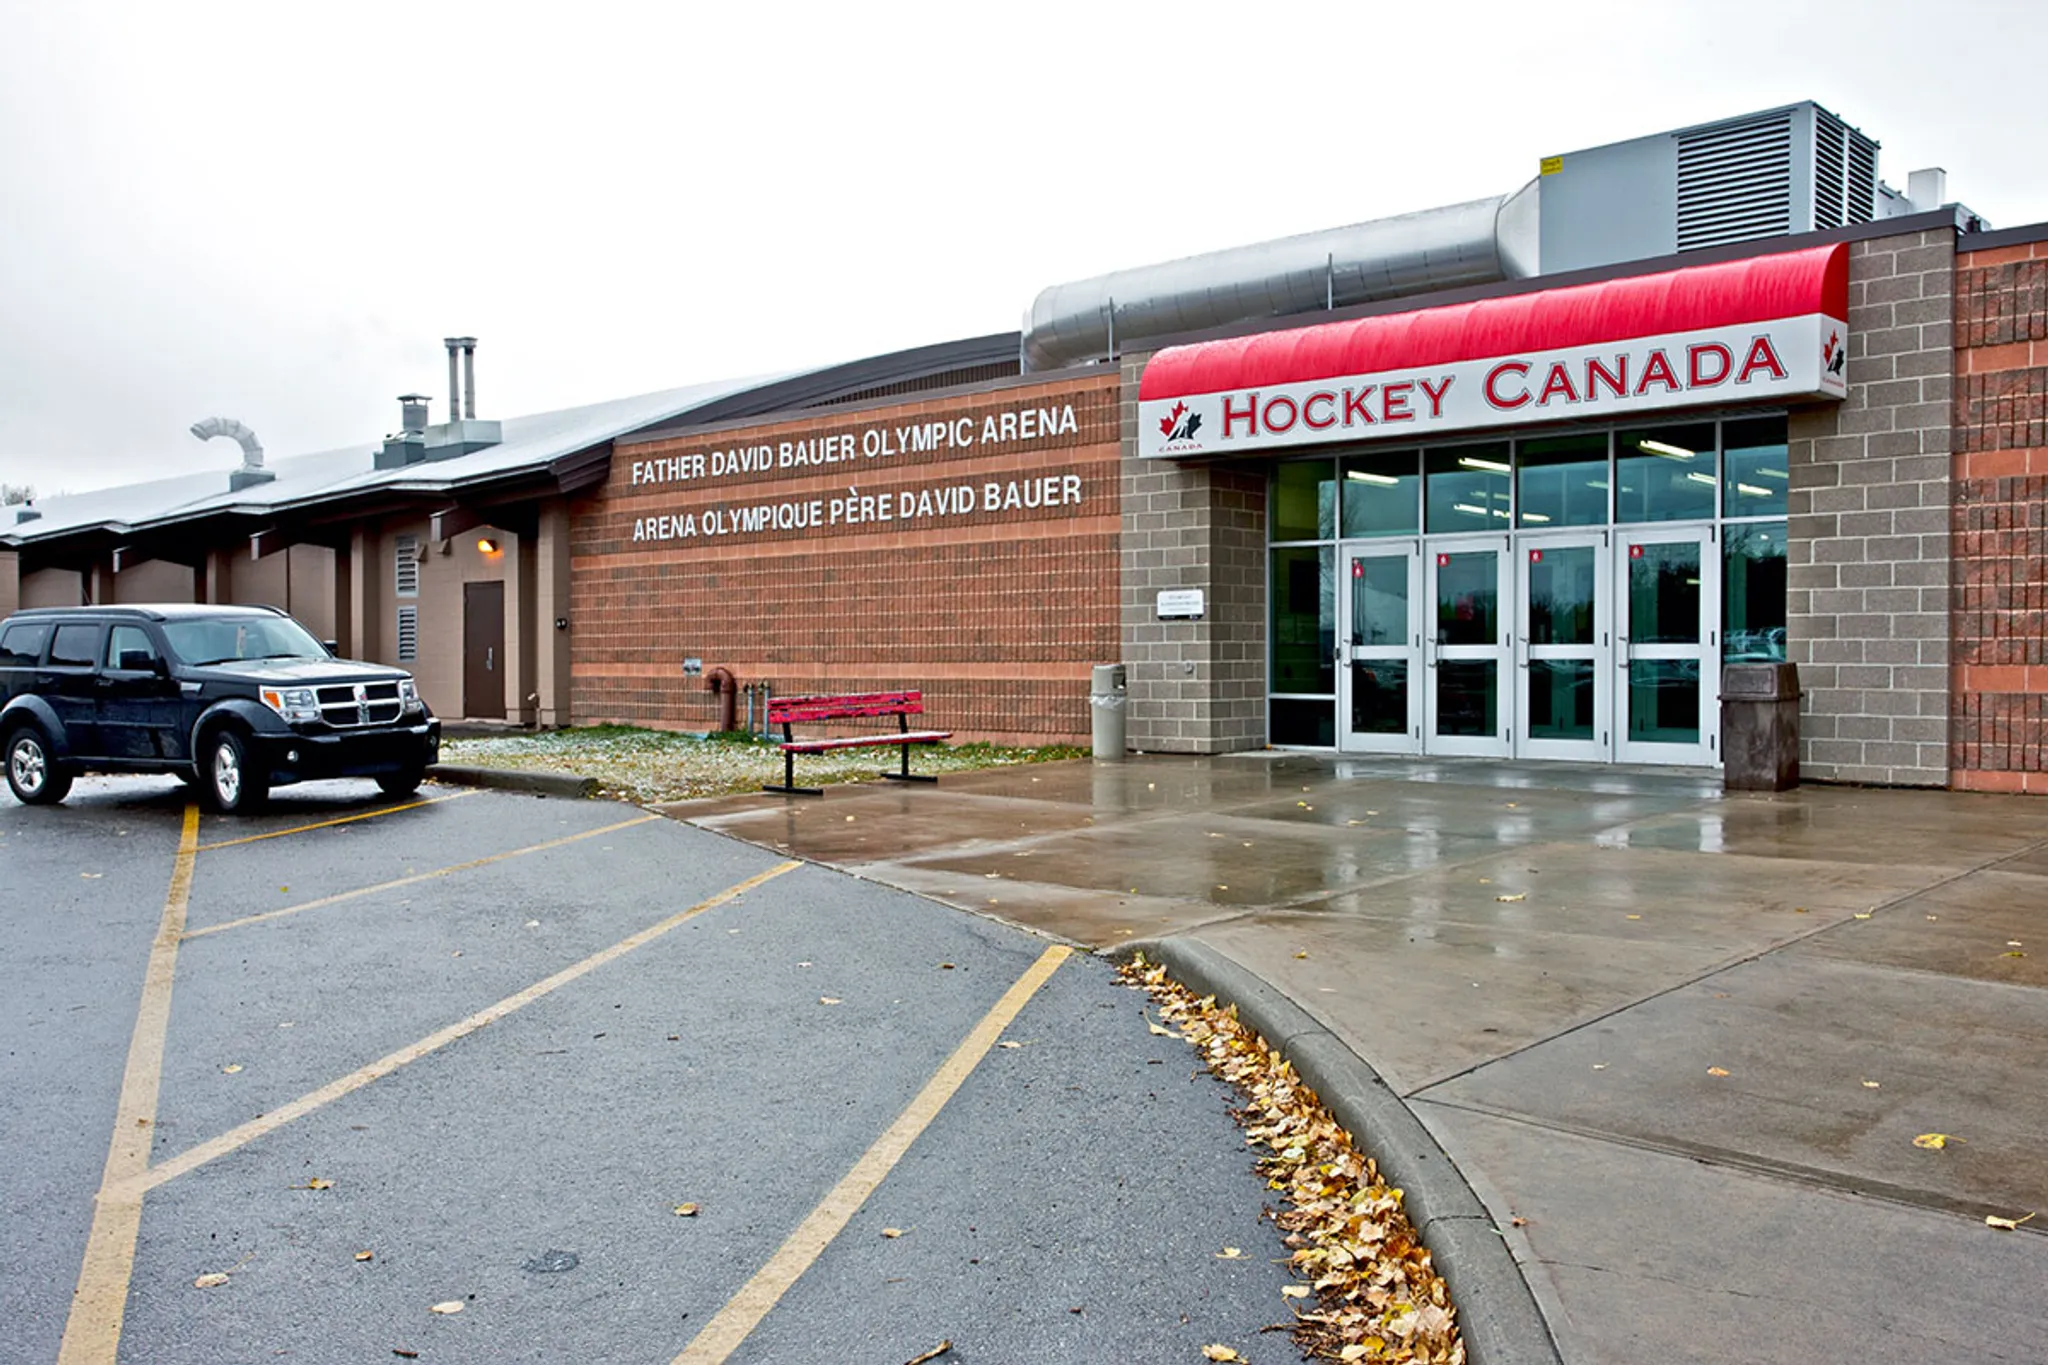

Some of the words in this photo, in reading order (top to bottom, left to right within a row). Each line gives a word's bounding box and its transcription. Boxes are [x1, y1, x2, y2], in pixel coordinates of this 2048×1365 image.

[1220, 374, 1456, 440] HOCKEY
[1482, 333, 1790, 411] CANADA
[632, 453, 705, 486] FATHER
[711, 445, 773, 476] DAVID
[779, 434, 855, 468] BAUER
[862, 417, 974, 457] OLYMPIC
[981, 404, 1079, 445] ARENA
[1158, 443, 1203, 453] CANADA
[632, 513, 697, 542] ARENA
[702, 500, 823, 535] OLYMPIQUE
[830, 486, 893, 525] PÈRE
[900, 486, 976, 519] DAVID
[984, 475, 1082, 511] BAUER
